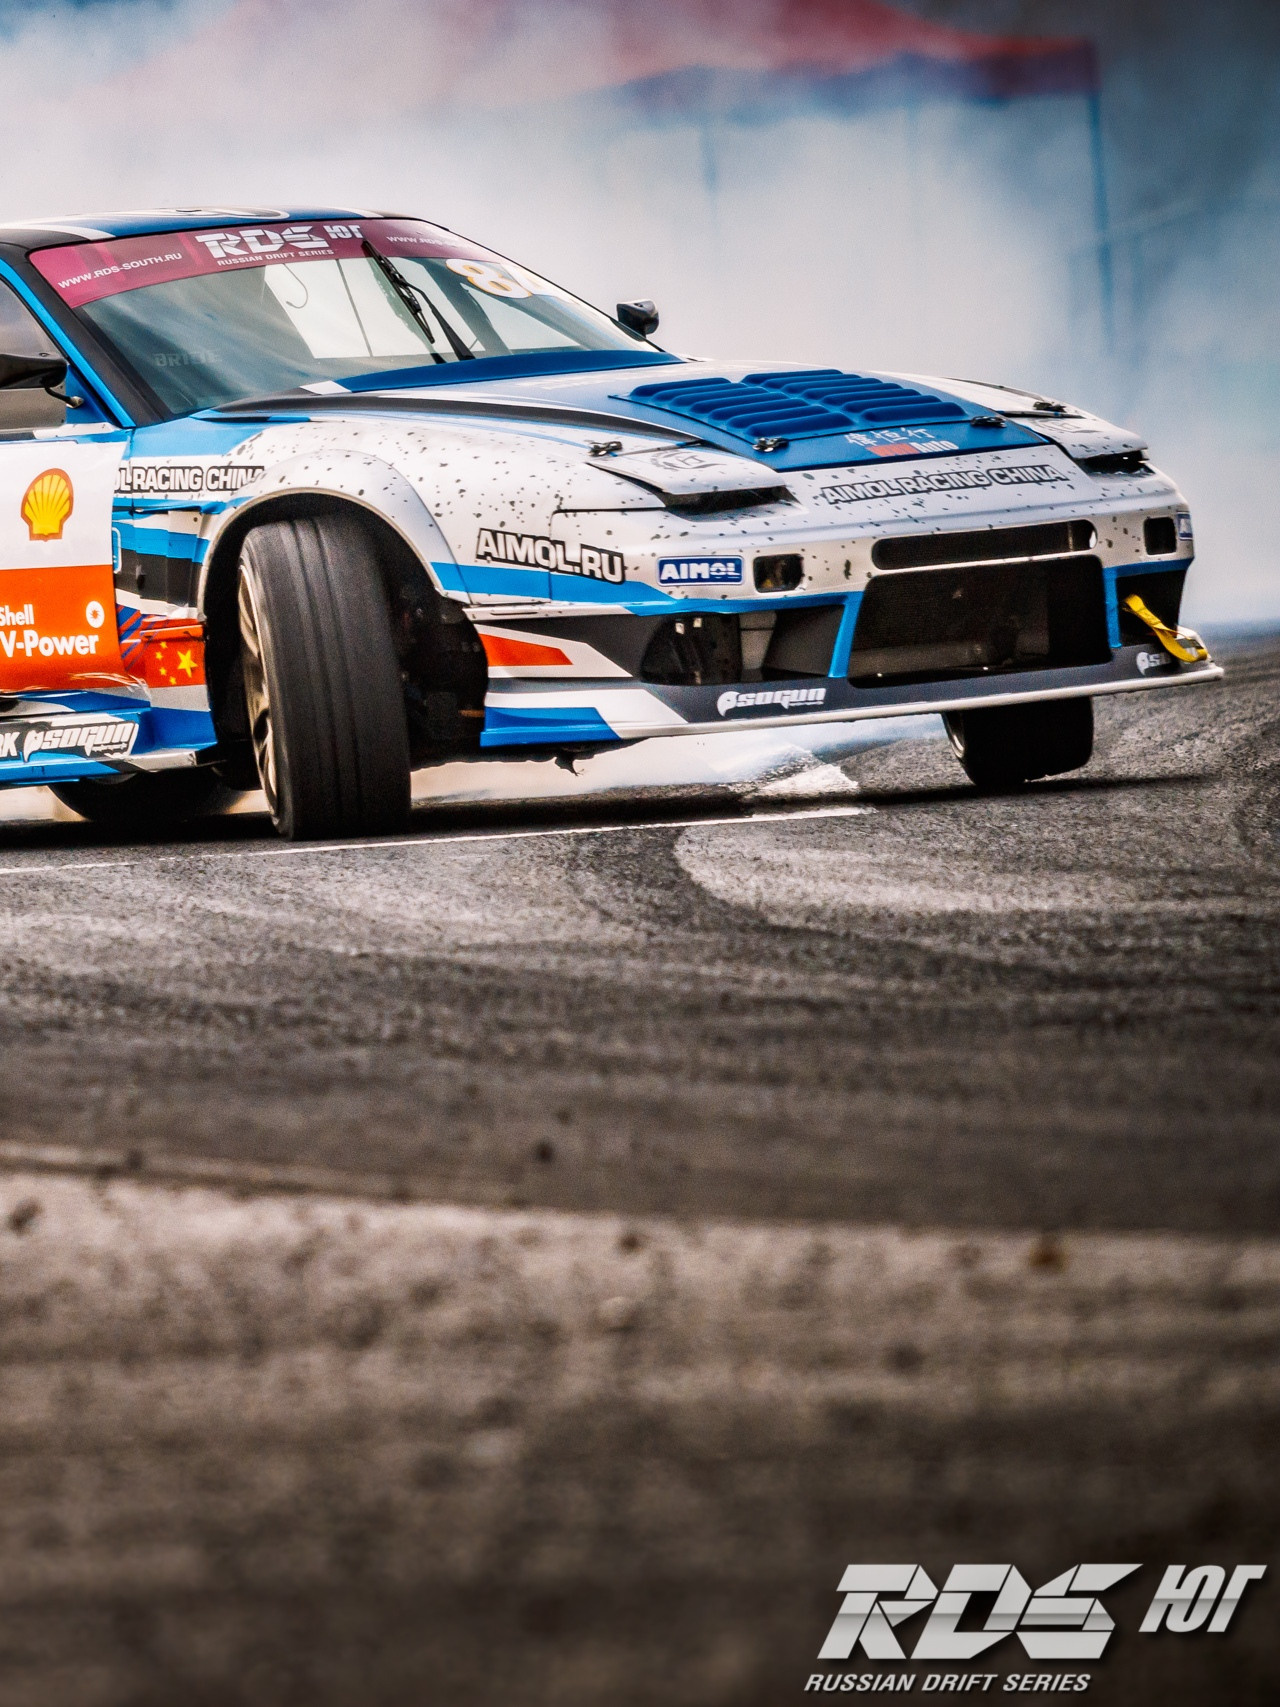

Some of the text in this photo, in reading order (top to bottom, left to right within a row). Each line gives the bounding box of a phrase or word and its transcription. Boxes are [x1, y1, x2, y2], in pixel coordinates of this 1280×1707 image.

[195, 225, 330, 259] RDS
[217, 248, 335, 267] RUSSIAN DRIFT SERIES
[57, 252, 183, 289] WWW.RDS-SOUTH.RU
[132, 467, 204, 491] RACING
[822, 465, 1067, 503] AIMOL RACING CHINA
[476, 530, 625, 582] AIMOL.RU
[660, 562, 740, 581] AIMOL
